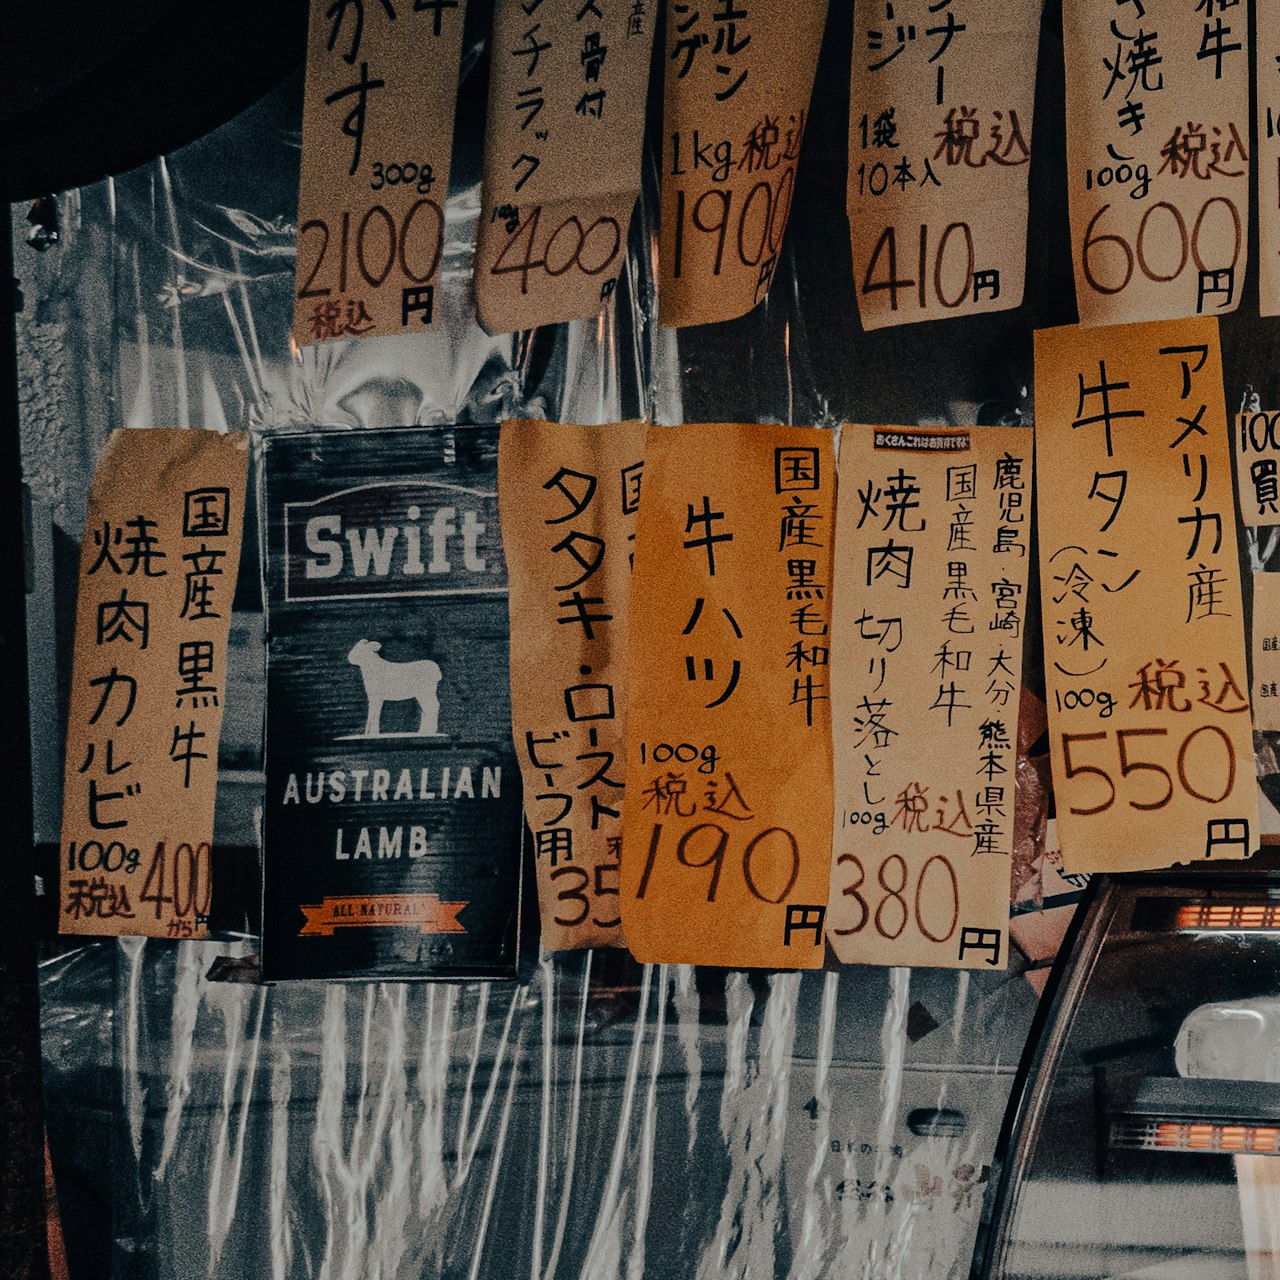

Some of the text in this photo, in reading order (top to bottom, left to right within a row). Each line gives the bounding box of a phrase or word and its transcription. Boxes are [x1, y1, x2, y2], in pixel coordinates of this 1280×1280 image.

[670, 129, 737, 182] 1kg
[858, 106, 900, 150] 1袋
[933, 106, 1031, 169] 税込
[370, 161, 436, 195] 300g
[857, 156, 942, 196] 10本入
[1085, 121, 1249, 200] 100g 税込
[307, 300, 374, 336] 税込
[1070, 359, 1145, 594] 牛タン
[1159, 343, 1233, 626] アメリカ産
[304, 504, 488, 581] Swift
[682, 495, 743, 710] 牛ハツ
[774, 446, 830, 727] 国産黒毛和牛
[928, 464, 979, 728] 国産黒毛和牛
[169, 486, 231, 789] 国産黒牛
[77, 514, 168, 831] 焼肉カルビ
[1055, 658, 1250, 719] 100g 税込
[281, 766, 502, 805] AUSTRALIAN
[639, 741, 721, 774] 100g
[526, 730, 574, 865] ビーフ用
[641, 771, 755, 821] 税込
[841, 781, 973, 838] 100g 税込
[67, 840, 142, 874] 100g
[335, 825, 429, 861] LAMB
[65, 876, 136, 920] 税込
[332, 904, 355, 917] ALL
